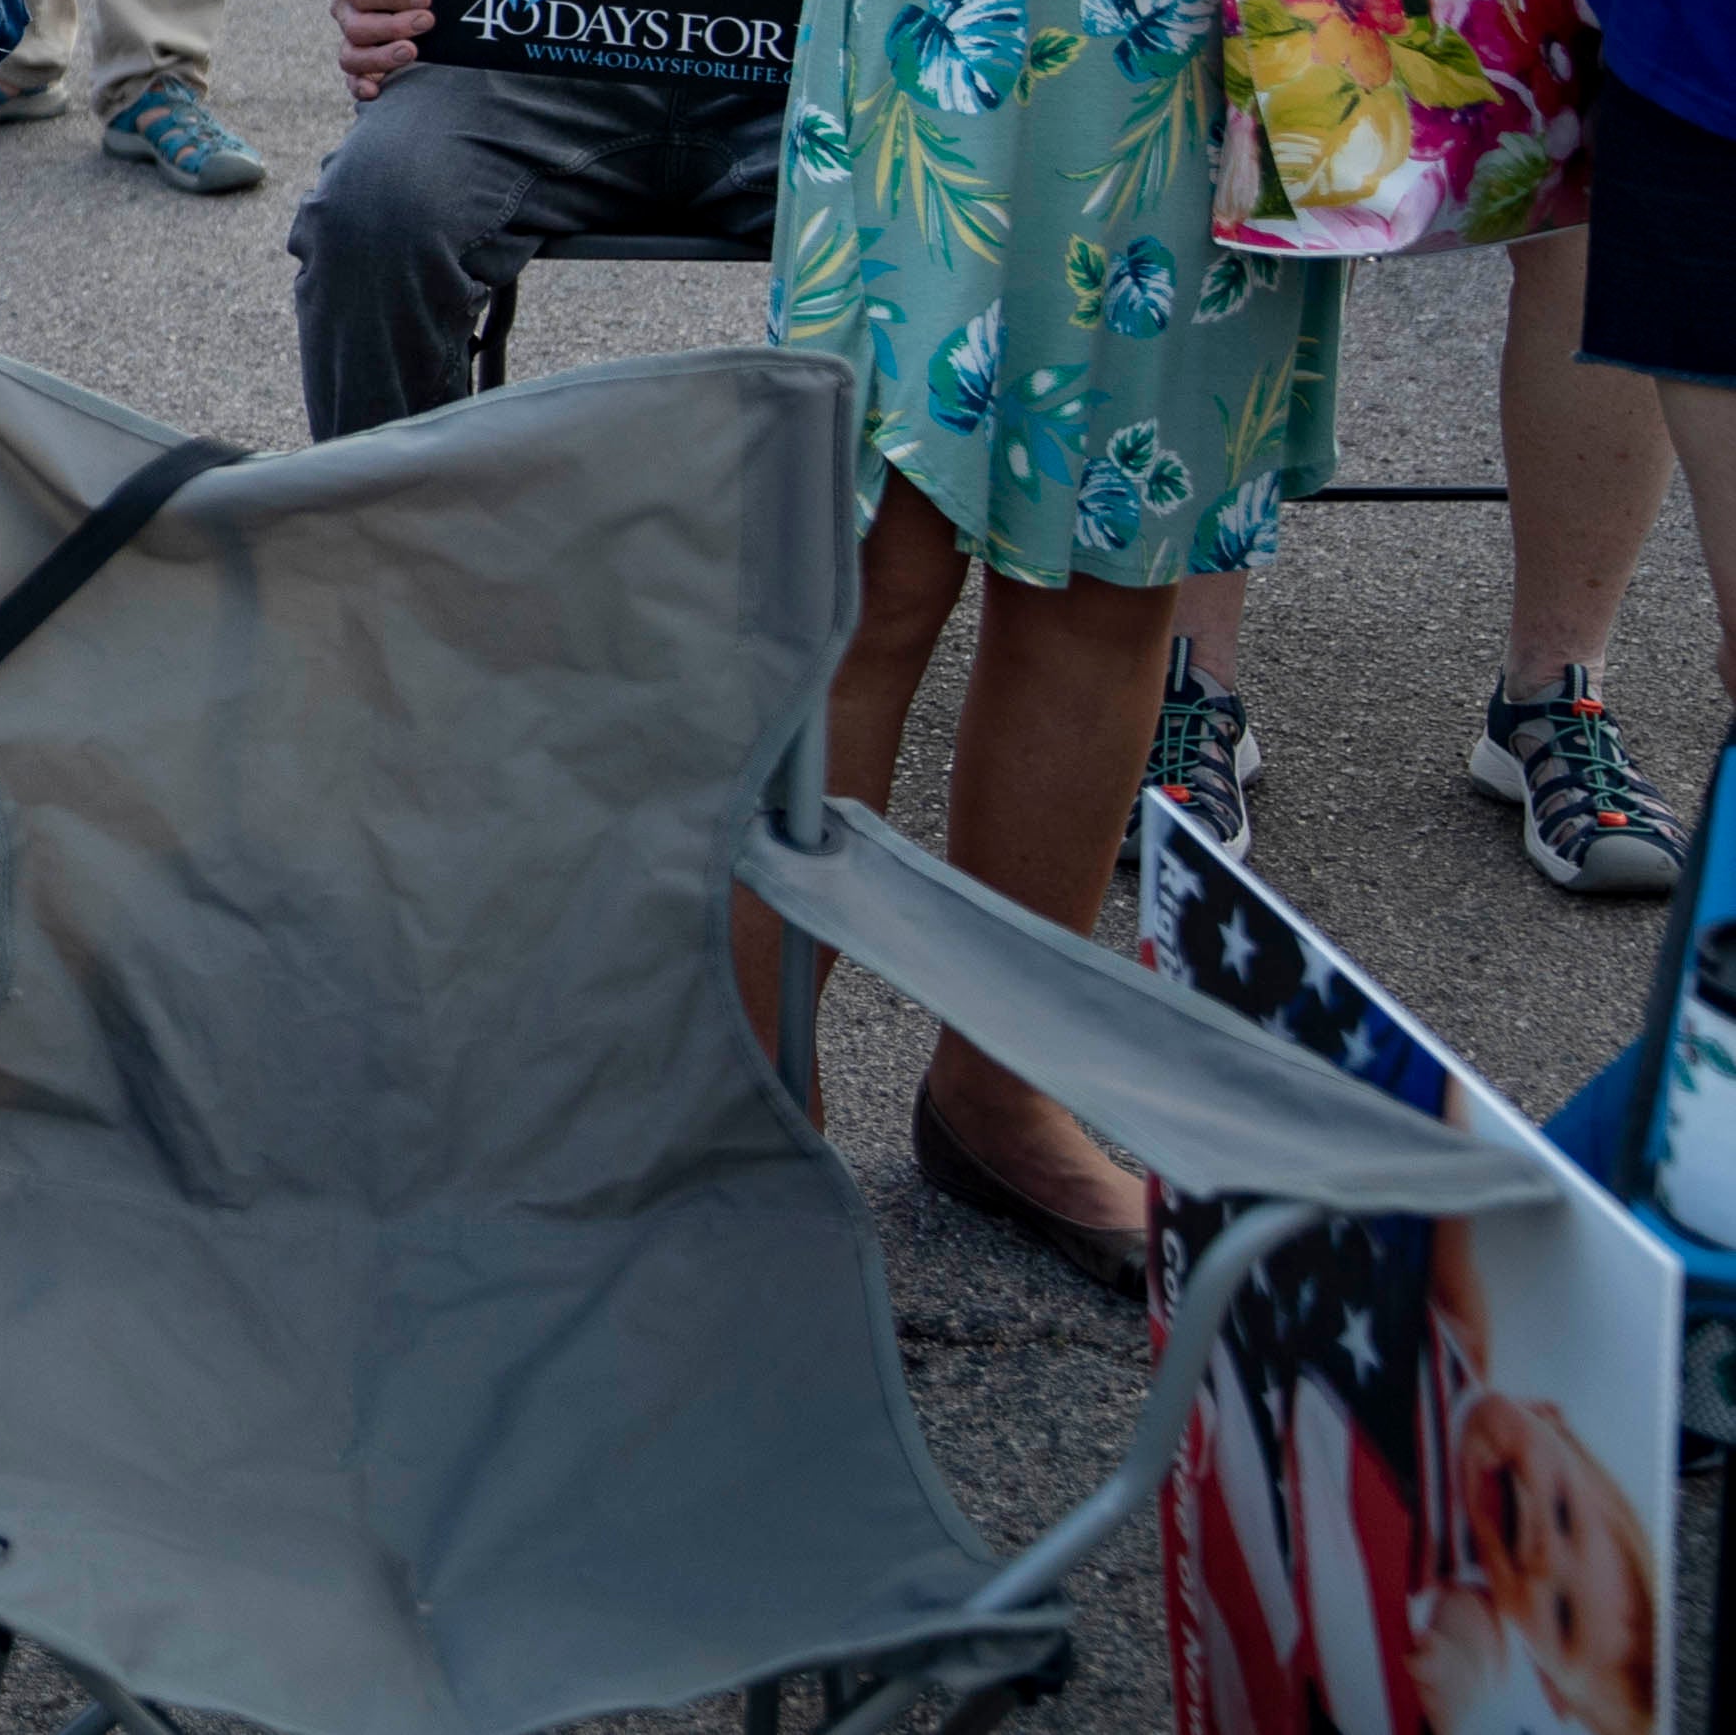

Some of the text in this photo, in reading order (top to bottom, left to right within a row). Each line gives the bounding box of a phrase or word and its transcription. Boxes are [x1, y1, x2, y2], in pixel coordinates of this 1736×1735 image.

[544, 0, 670, 52] DAYS
[677, 12, 792, 63] FOR
[524, 42, 792, 84] WWW.40DAYSFORLIFE.C
